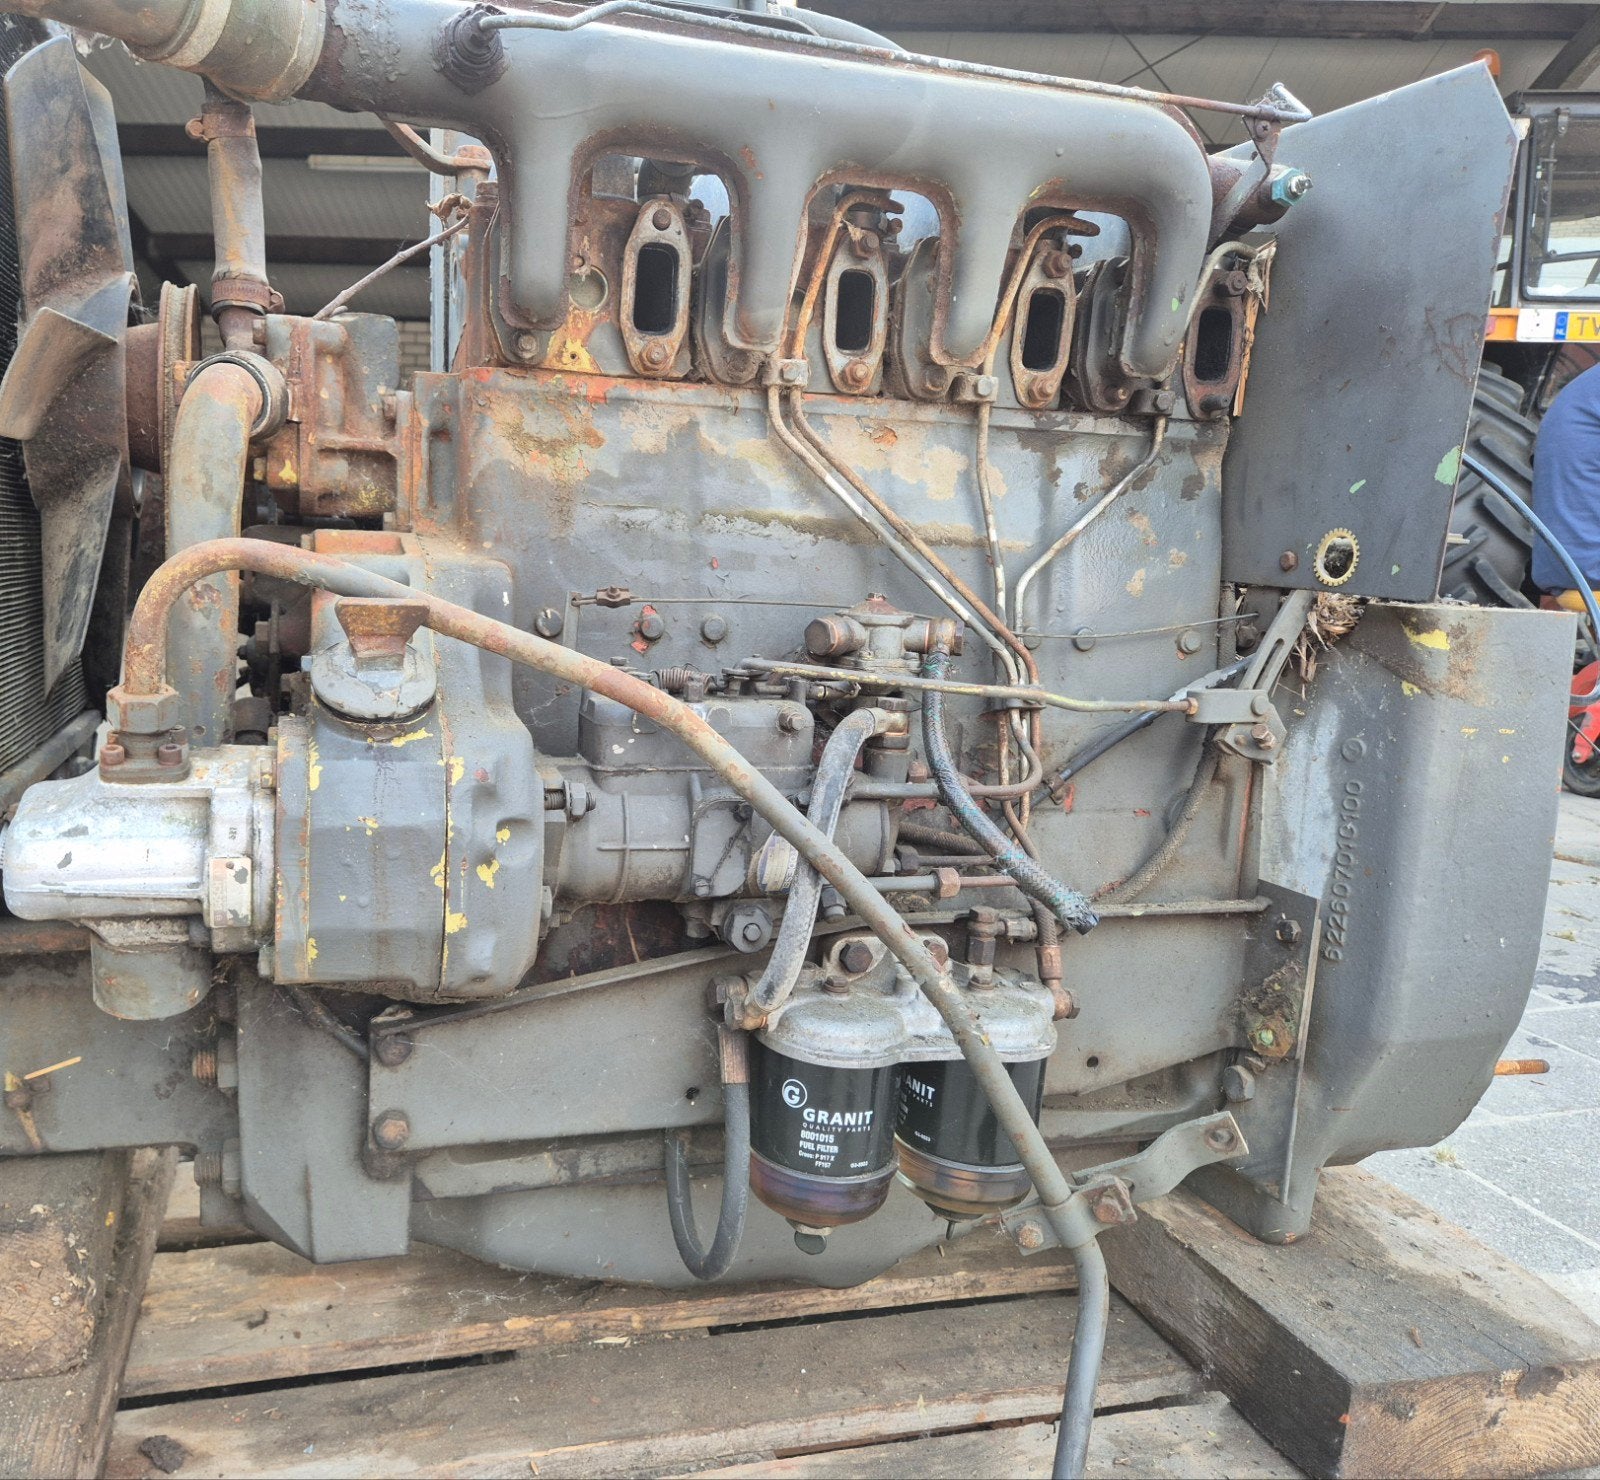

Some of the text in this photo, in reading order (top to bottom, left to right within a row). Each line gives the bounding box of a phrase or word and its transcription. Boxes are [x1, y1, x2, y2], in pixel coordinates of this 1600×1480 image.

[1555, 328, 1565, 336] NL
[905, 1075, 935, 1100] ANIT
[803, 1108, 873, 1126] GRANIT
[802, 1122, 842, 1132] QUALITY
[801, 1130, 835, 1143] 8001015
[799, 1141, 838, 1154] FUEL FILTER
